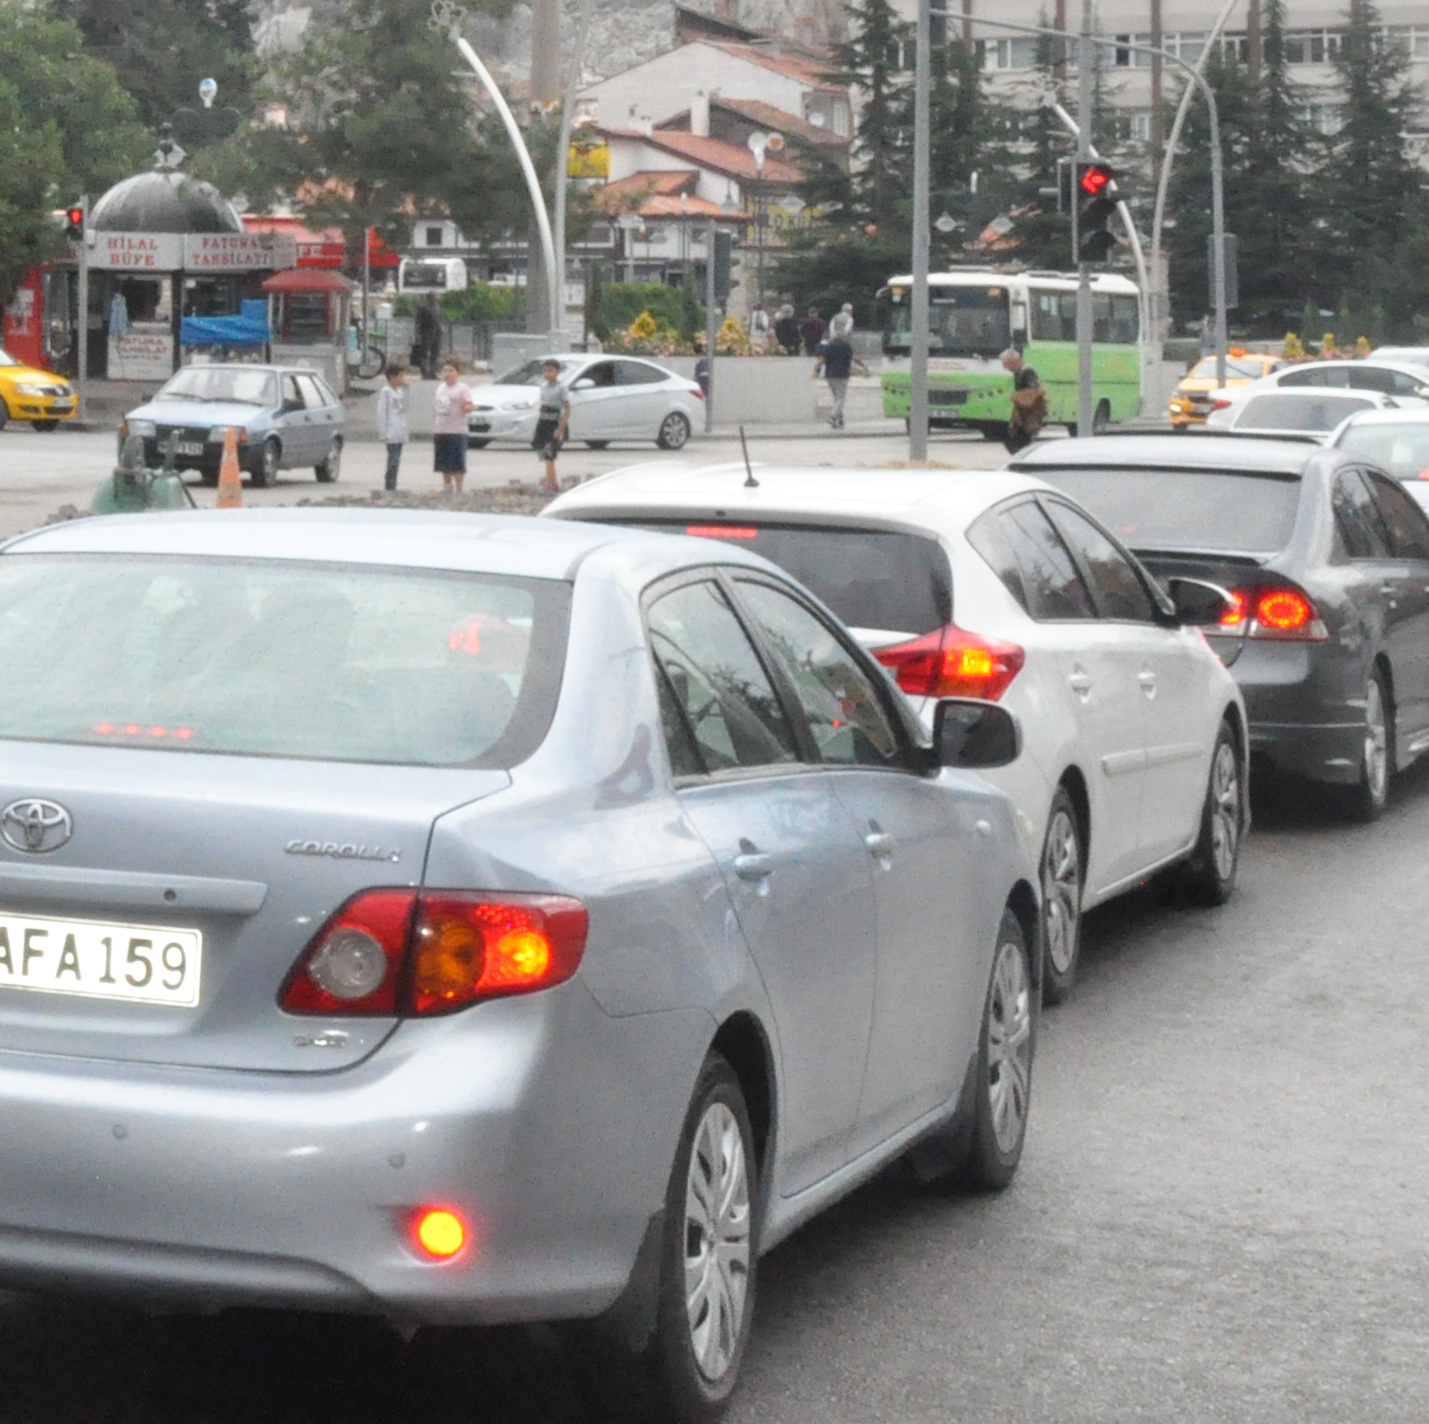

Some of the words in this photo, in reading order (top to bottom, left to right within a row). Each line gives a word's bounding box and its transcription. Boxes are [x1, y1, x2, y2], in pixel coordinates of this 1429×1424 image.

[107, 236, 159, 250] HİLAL
[202, 237, 258, 250] FATURA
[110, 252, 155, 266] BÜFE
[284, 839, 400, 862] COROLLA
[99, 936, 187, 991] 159
